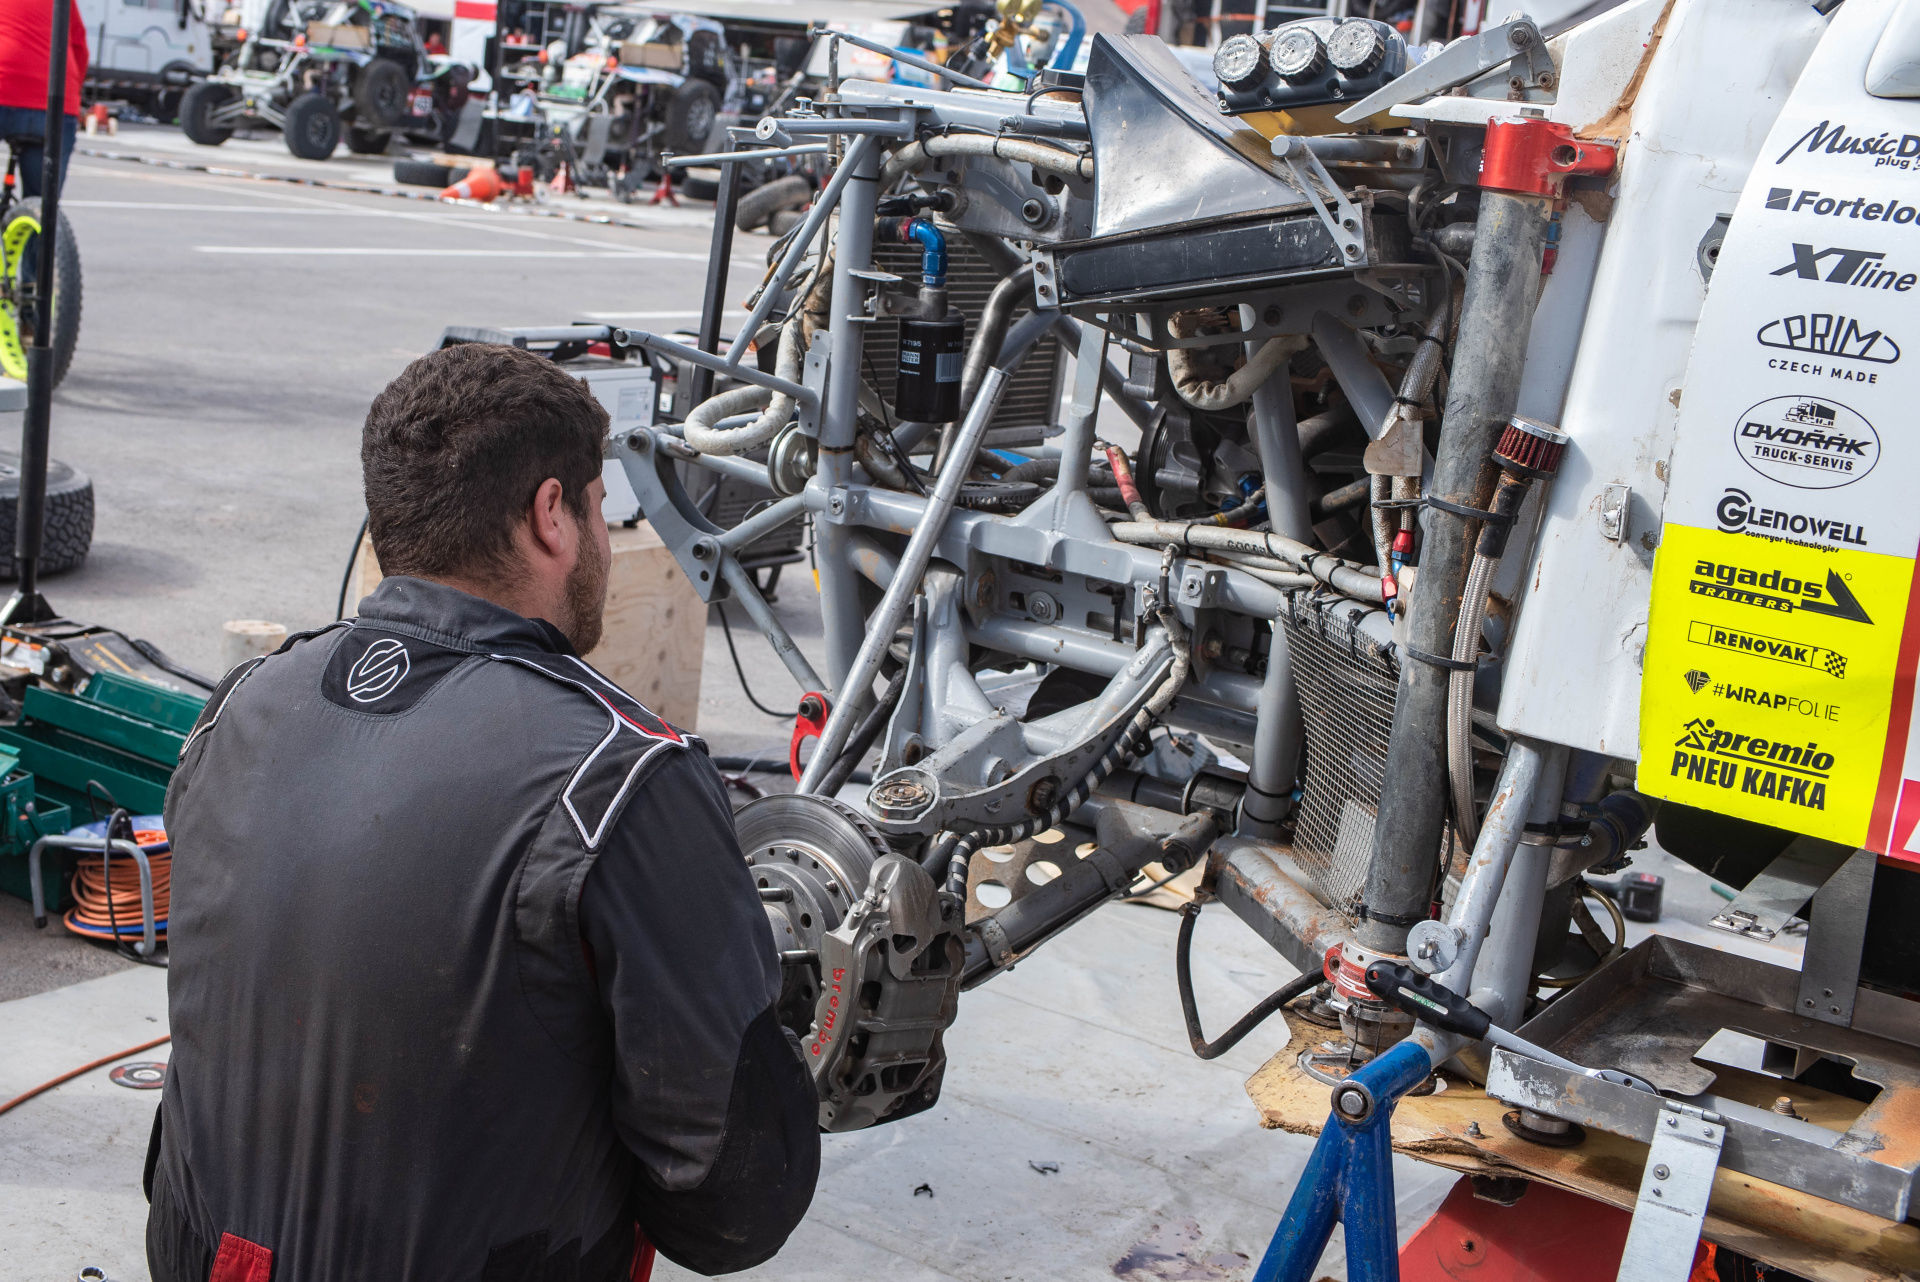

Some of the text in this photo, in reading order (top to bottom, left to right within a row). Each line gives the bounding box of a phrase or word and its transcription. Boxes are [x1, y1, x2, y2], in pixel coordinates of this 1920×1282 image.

[1875, 156, 1910, 170] plug
[1783, 313, 1882, 358] PRIM
[1768, 358, 1878, 384] CZECH MADE
[1740, 421, 1872, 457] DVOŘÁK
[1754, 445, 1854, 471] TRUCK-SERVIS
[1745, 530, 1840, 554] conveyor technologies
[1694, 559, 1823, 600] agados
[1691, 583, 1792, 613] TRAILERS
[1714, 630, 1809, 663] RENOVAK
[1707, 728, 1834, 771] premio
[1670, 750, 1826, 812] PNEU KAFKA
[811, 967, 846, 1056] brembo
